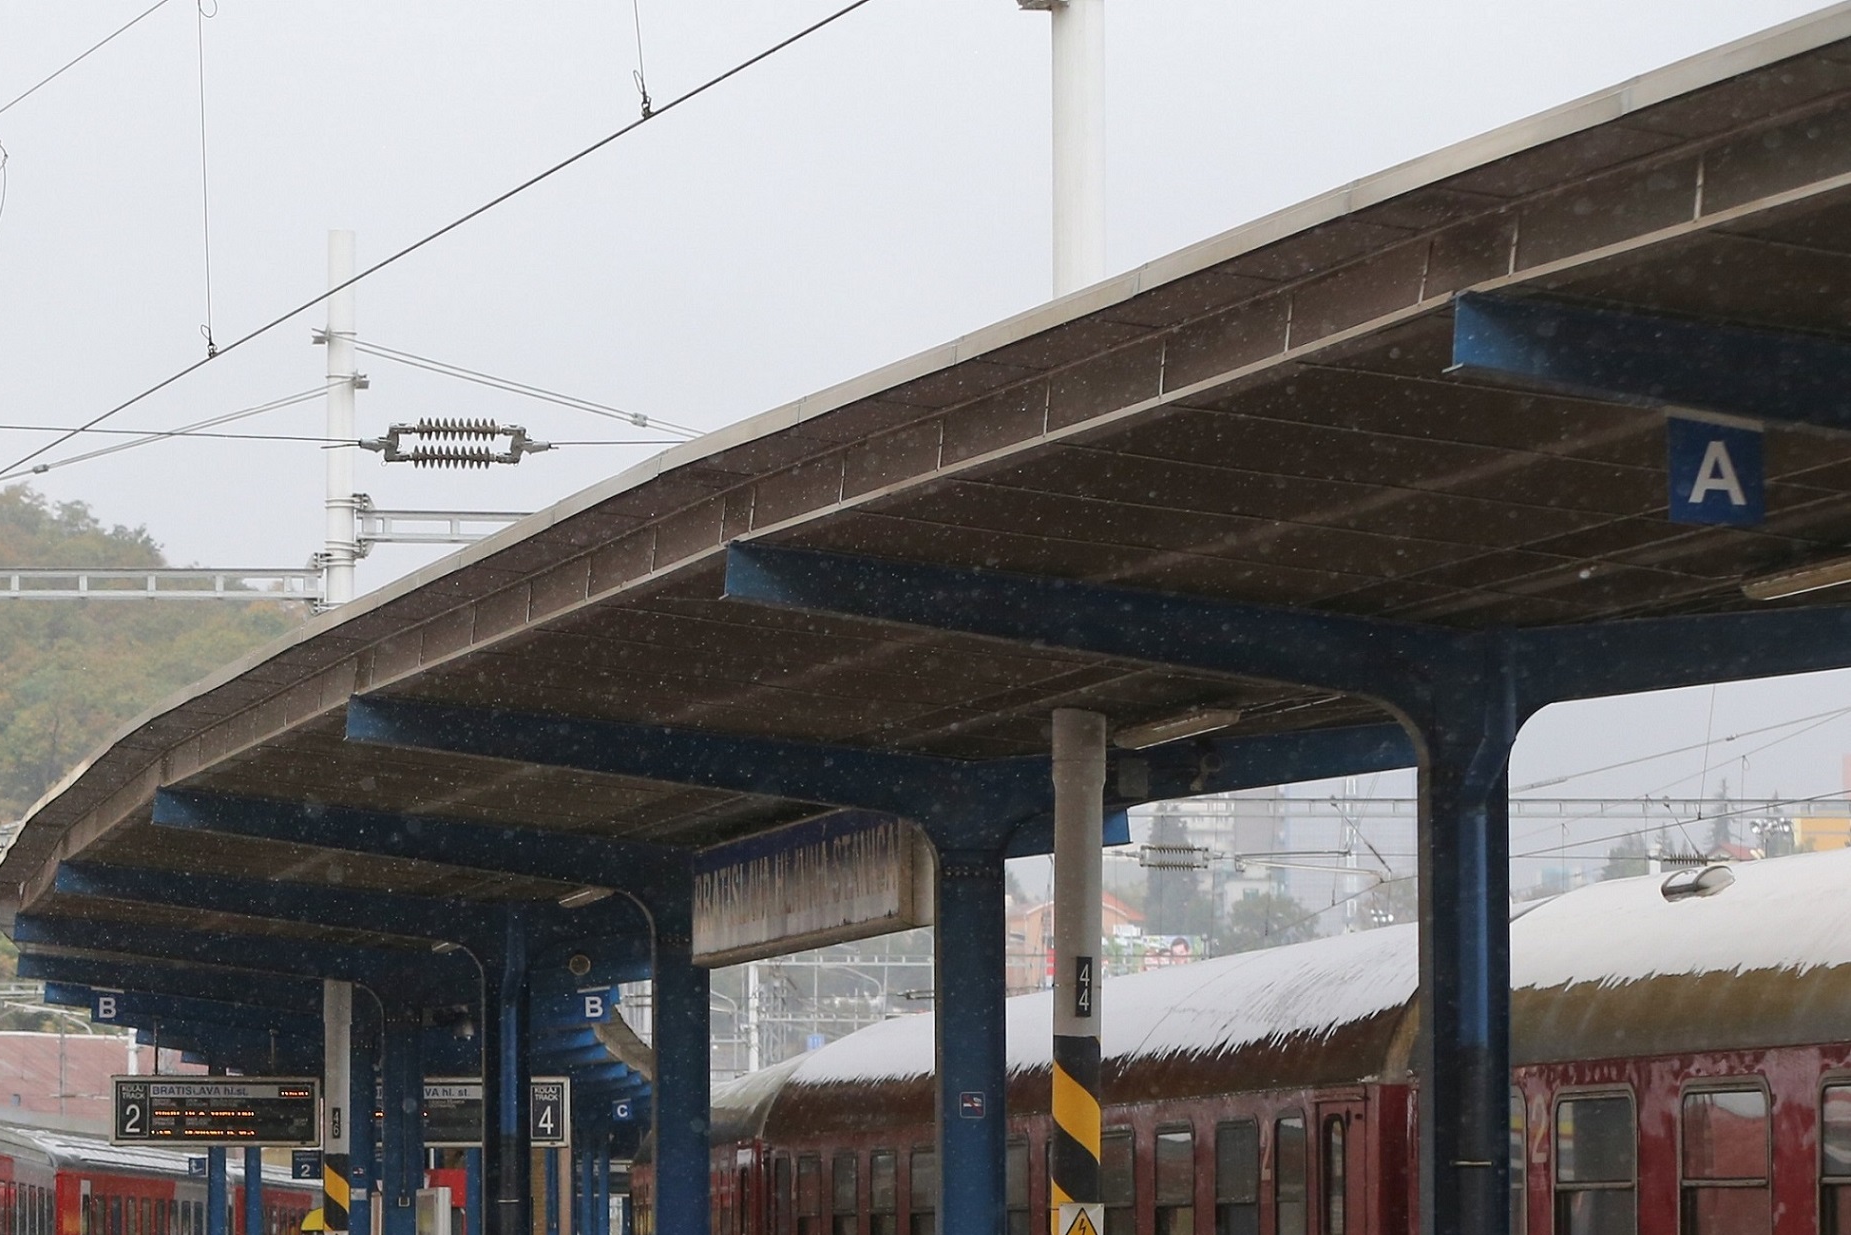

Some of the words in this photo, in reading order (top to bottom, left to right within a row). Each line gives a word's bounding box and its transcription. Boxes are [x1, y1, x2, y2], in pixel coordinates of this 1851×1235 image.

[1688, 440, 1747, 506] A
[99, 997, 117, 1019] B
[585, 996, 604, 1018] B
[152, 1085, 221, 1096] BRATISLAVA
[124, 1104, 141, 1133] 2
[538, 1105, 554, 1135] 4
[617, 1104, 629, 1118] C
[300, 1163, 311, 1178] 2
